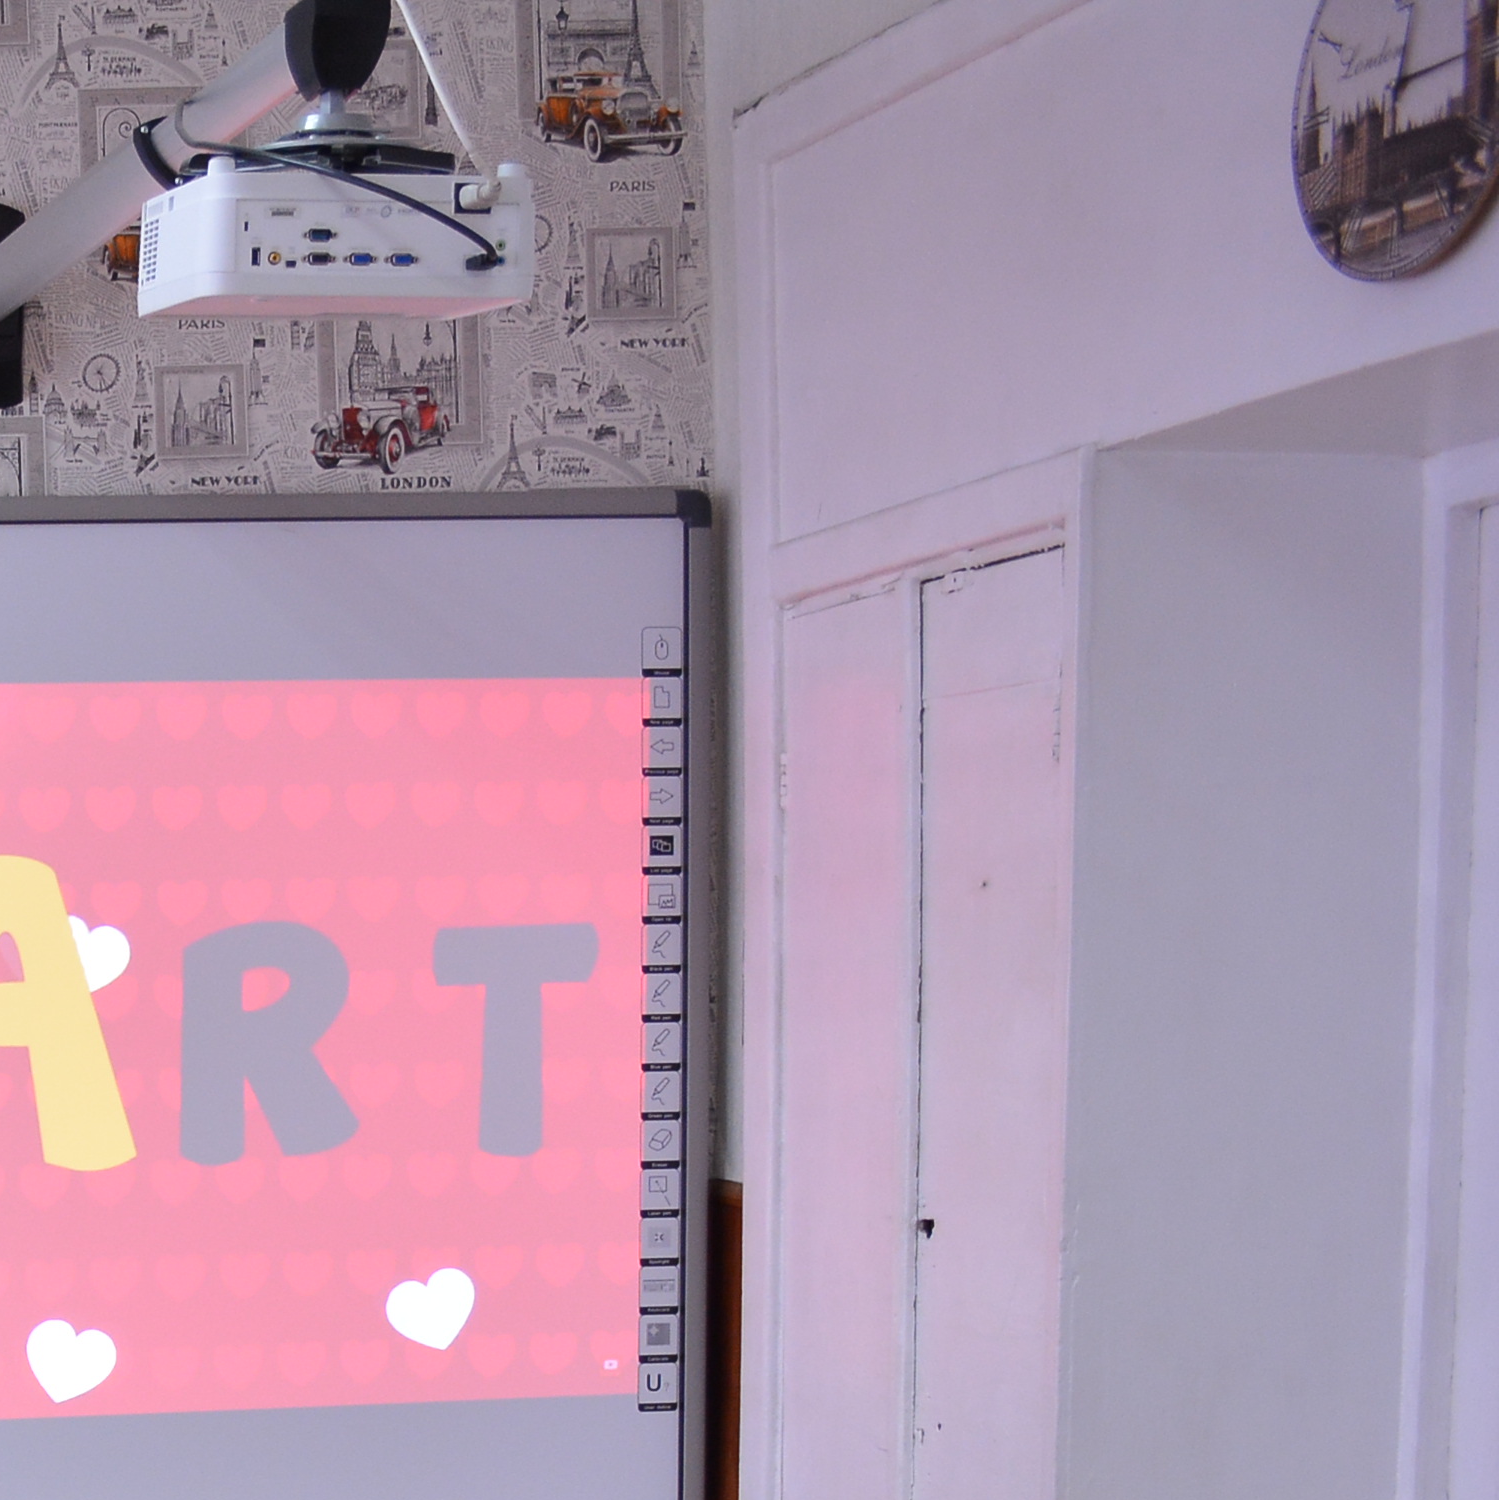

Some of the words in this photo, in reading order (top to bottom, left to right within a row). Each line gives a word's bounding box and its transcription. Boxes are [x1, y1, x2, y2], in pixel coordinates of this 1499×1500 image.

[610, 180, 656, 192] PARIS
[179, 319, 225, 330] PARIS
[621, 338, 650, 349] NEW
[653, 337, 689, 347] YORK
[191, 476, 221, 487] NEW
[225, 475, 260, 486] YORK
[380, 476, 453, 489] LONDON
